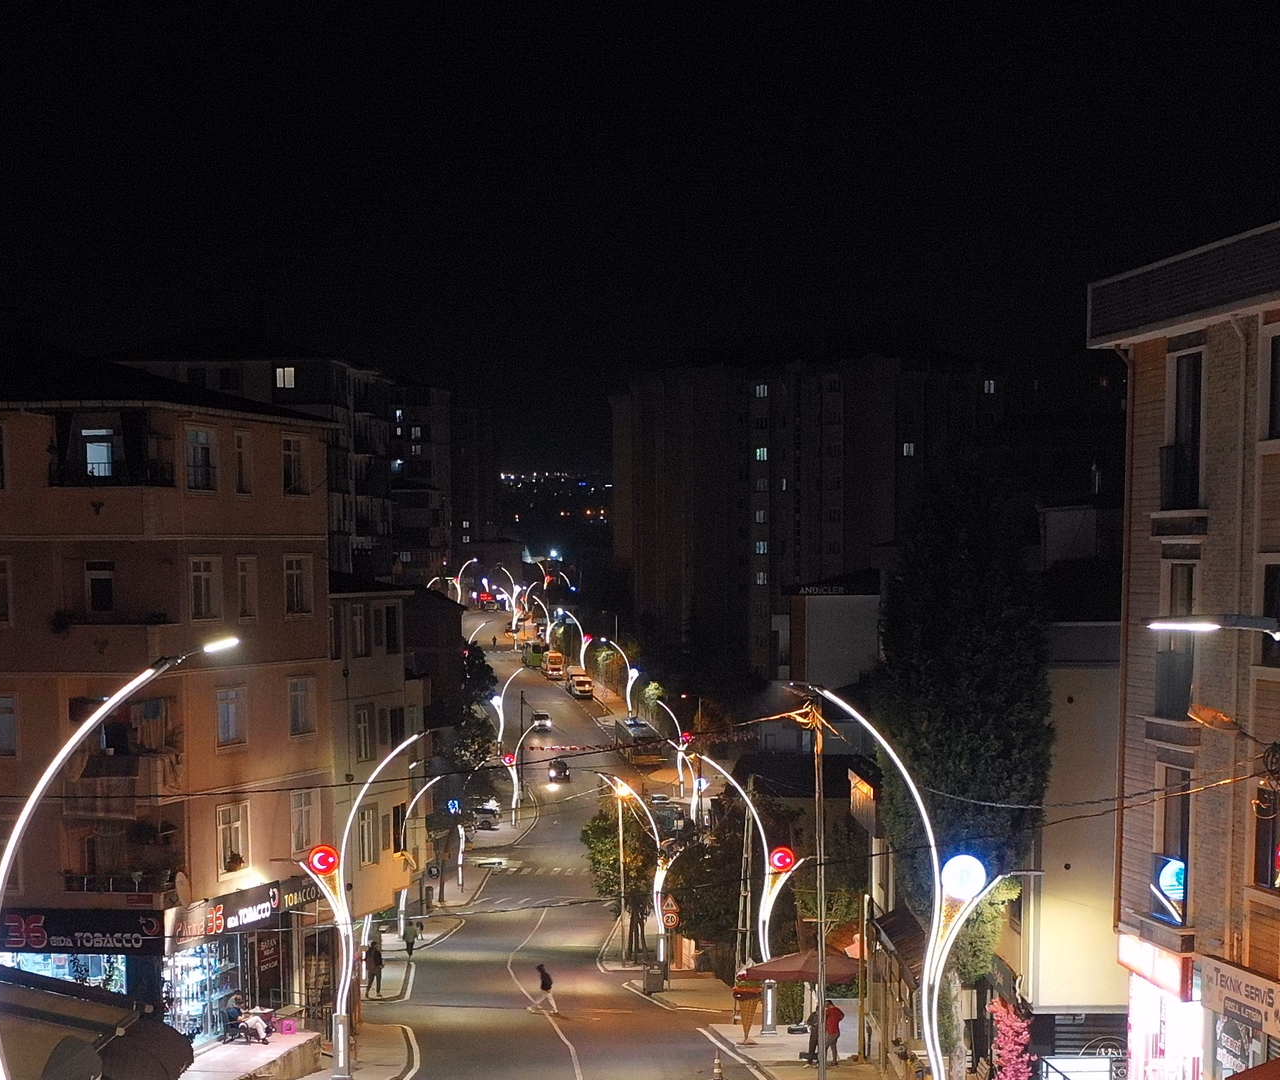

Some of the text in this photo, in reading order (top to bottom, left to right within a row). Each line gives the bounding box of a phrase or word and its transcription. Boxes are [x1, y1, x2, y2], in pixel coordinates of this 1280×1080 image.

[283, 886, 316, 908] TOBACCO
[4, 914, 48, 949] 36
[74, 931, 145, 949] TOBACCO
[206, 904, 224, 935] 36
[665, 915, 676, 924] 20
[1245, 984, 1275, 1009] SERVİS
